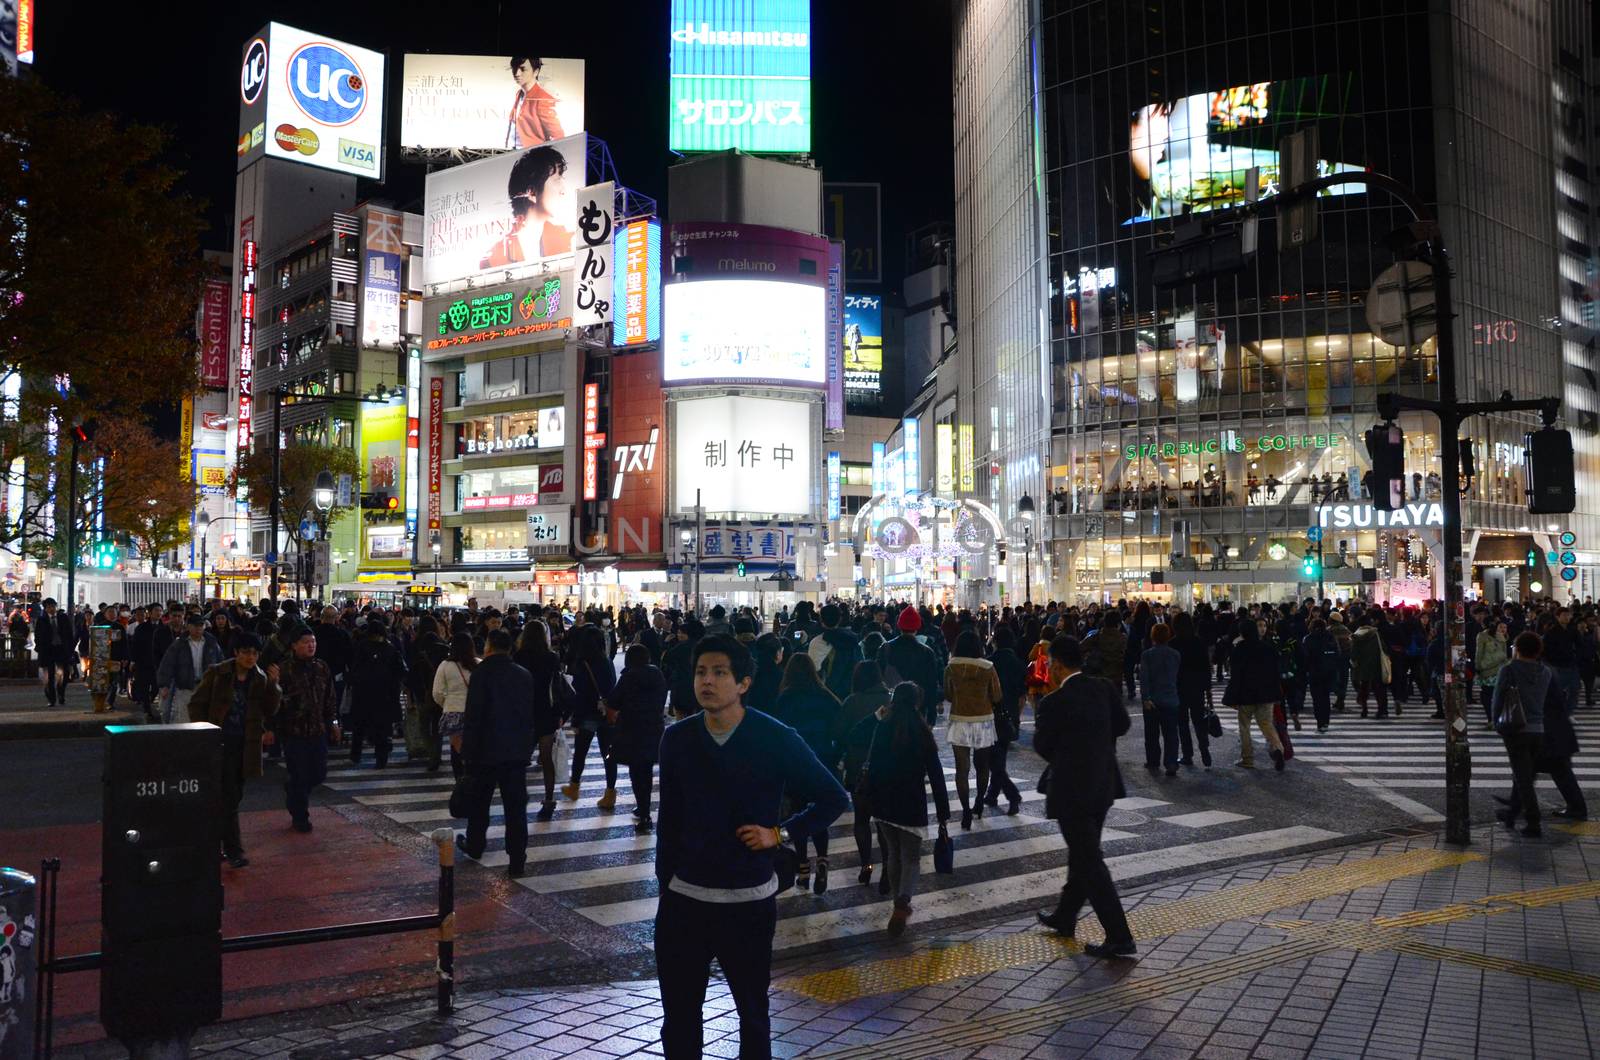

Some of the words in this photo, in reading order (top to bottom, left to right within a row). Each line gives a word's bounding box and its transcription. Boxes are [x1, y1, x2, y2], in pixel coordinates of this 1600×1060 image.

[297, 57, 361, 109] UC
[407, 75, 463, 88] 三浦大知
[677, 98, 804, 126] サロンパス
[275, 130, 319, 149] MasterCard
[343, 146, 374, 163] VISA
[428, 189, 474, 212] 三浦大知
[430, 209, 449, 221] NEW
[450, 202, 479, 217] ALBUM
[368, 211, 402, 251] 本
[708, 230, 740, 239] チャンネル
[577, 199, 612, 319] もんじゃ
[627, 226, 643, 337] 三千里薬品
[471, 303, 513, 329] 西村
[205, 283, 223, 381] Essential
[431, 398, 441, 484] ウィンターフルーツギフト
[1126, 438, 1246, 461] STARBUCKS
[1258, 433, 1340, 451] COFFEE
[613, 427, 660, 499] クスリ
[704, 439, 794, 470] 制作中
[541, 468, 563, 487] JTB
[1315, 503, 1444, 528] TSUTAYA
[534, 525, 557, 541] 松川
[136, 779, 199, 797] 331-06
